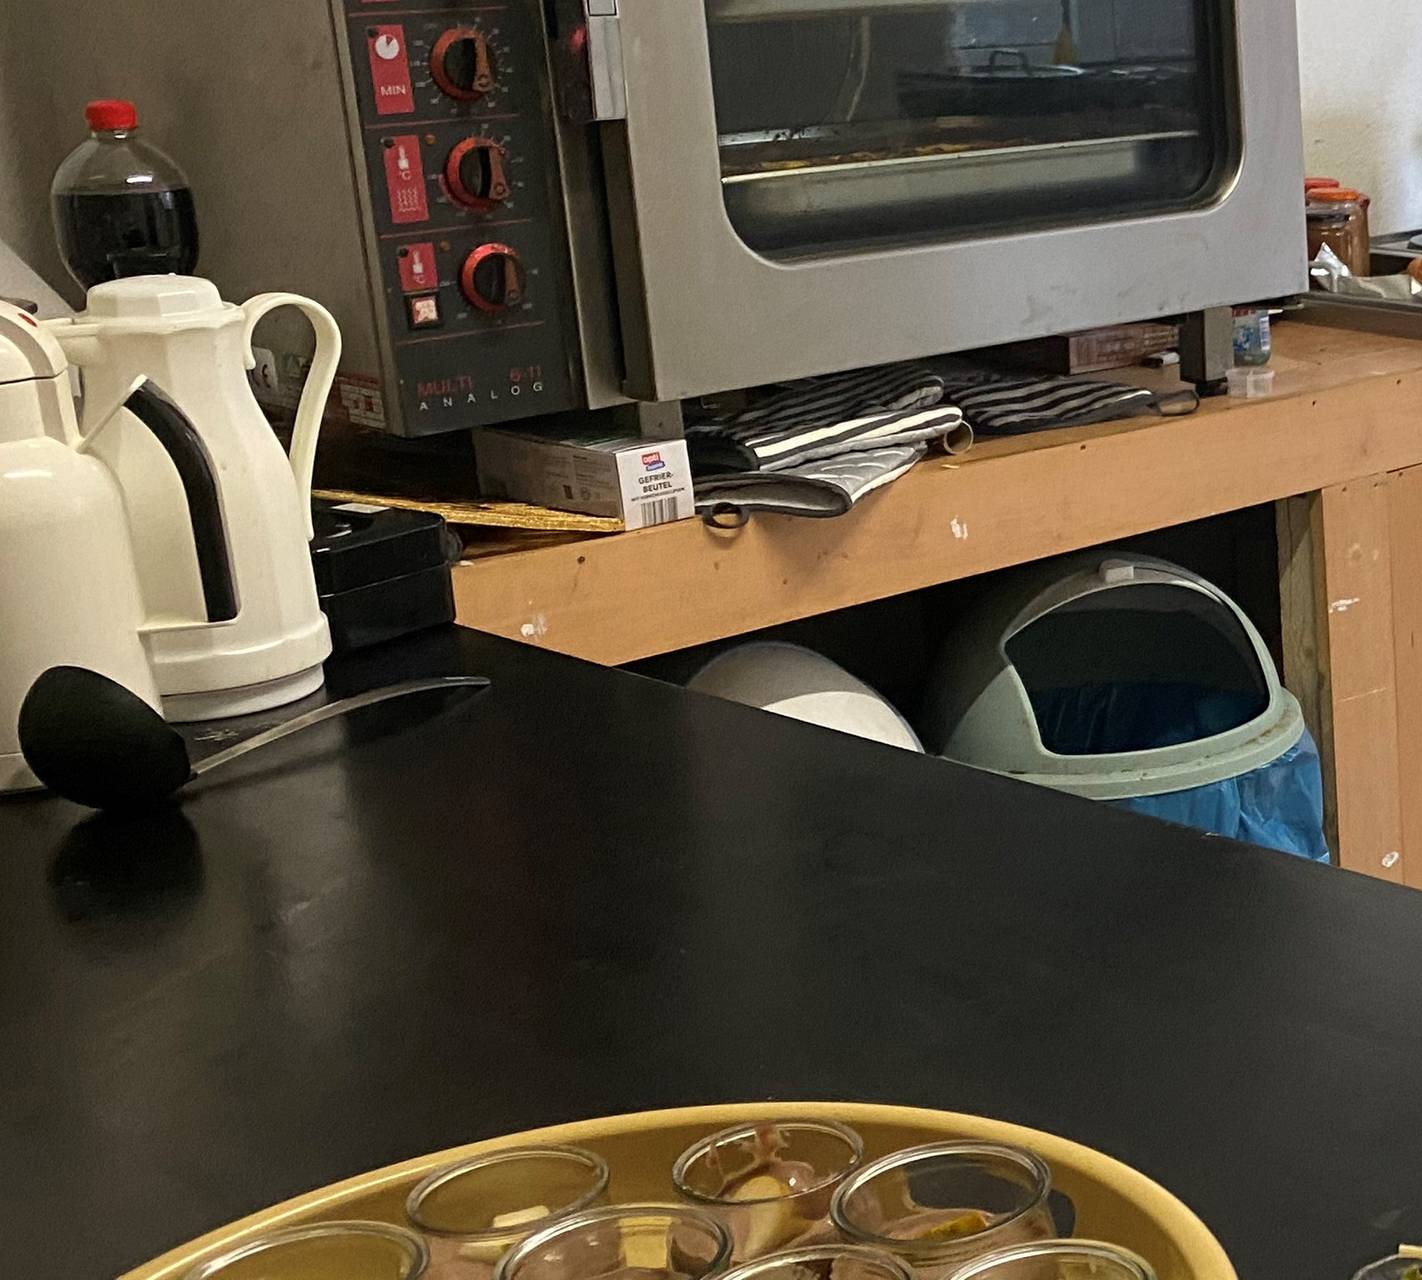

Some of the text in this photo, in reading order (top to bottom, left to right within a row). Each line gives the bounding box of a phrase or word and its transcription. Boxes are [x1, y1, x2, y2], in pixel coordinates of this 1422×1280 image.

[380, 85, 406, 96] MIN
[417, 375, 472, 397] MULTI
[638, 470, 674, 485] GEFRIER-
[642, 481, 673, 493] BEUTEL
